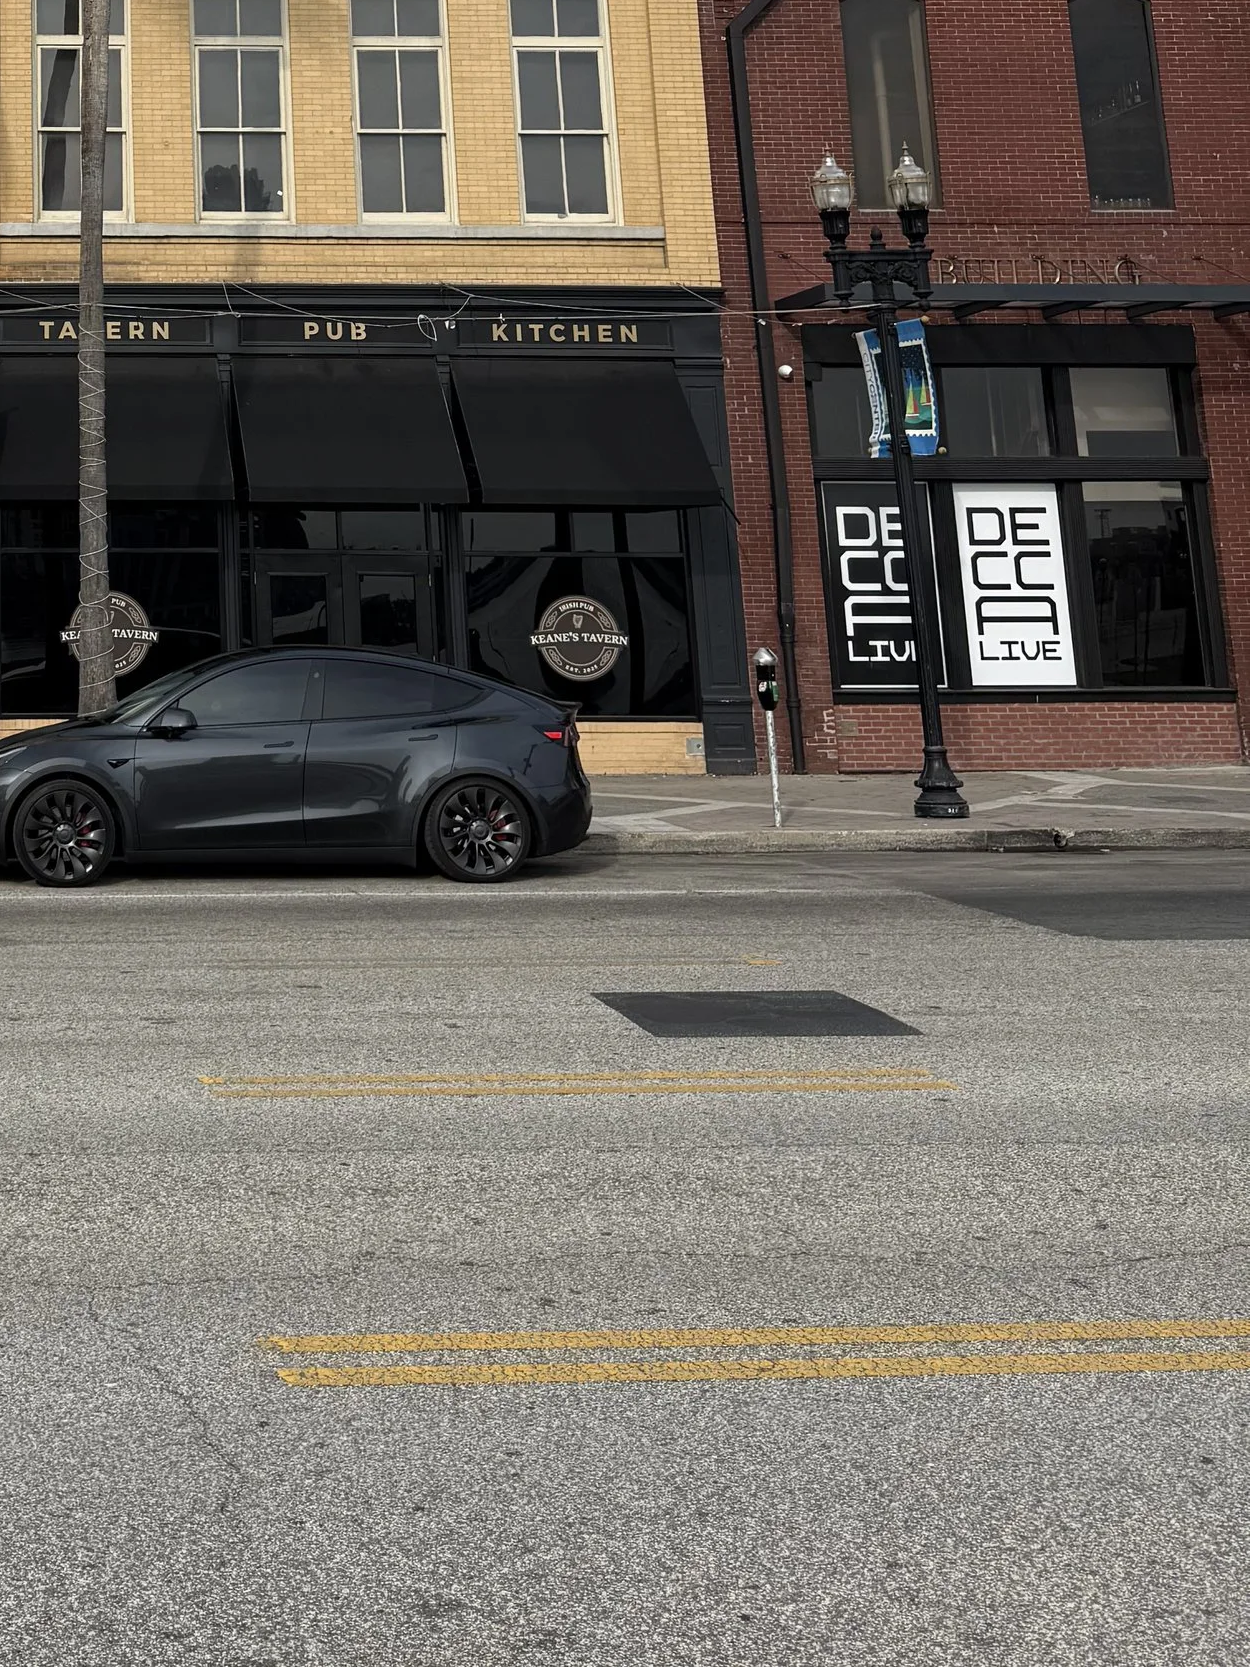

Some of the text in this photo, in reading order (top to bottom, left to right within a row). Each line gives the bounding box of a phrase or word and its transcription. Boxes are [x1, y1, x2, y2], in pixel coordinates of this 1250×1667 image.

[933, 258, 1142, 285] BUILDING
[39, 321, 169, 340] TAERN
[303, 322, 367, 340] PUB
[492, 323, 638, 343] KITCHEN
[965, 506, 1050, 546] DE
[971, 550, 1055, 590] CC
[111, 597, 127, 608] PUB
[558, 602, 595, 612] IRISH PUB
[975, 596, 1059, 635] A
[111, 628, 158, 641] TAVERN
[530, 632, 628, 646] KEANE'S TAVERN
[847, 640, 917, 662] LIV
[979, 640, 1062, 661] LIVE
[565, 665, 581, 674] EST.
